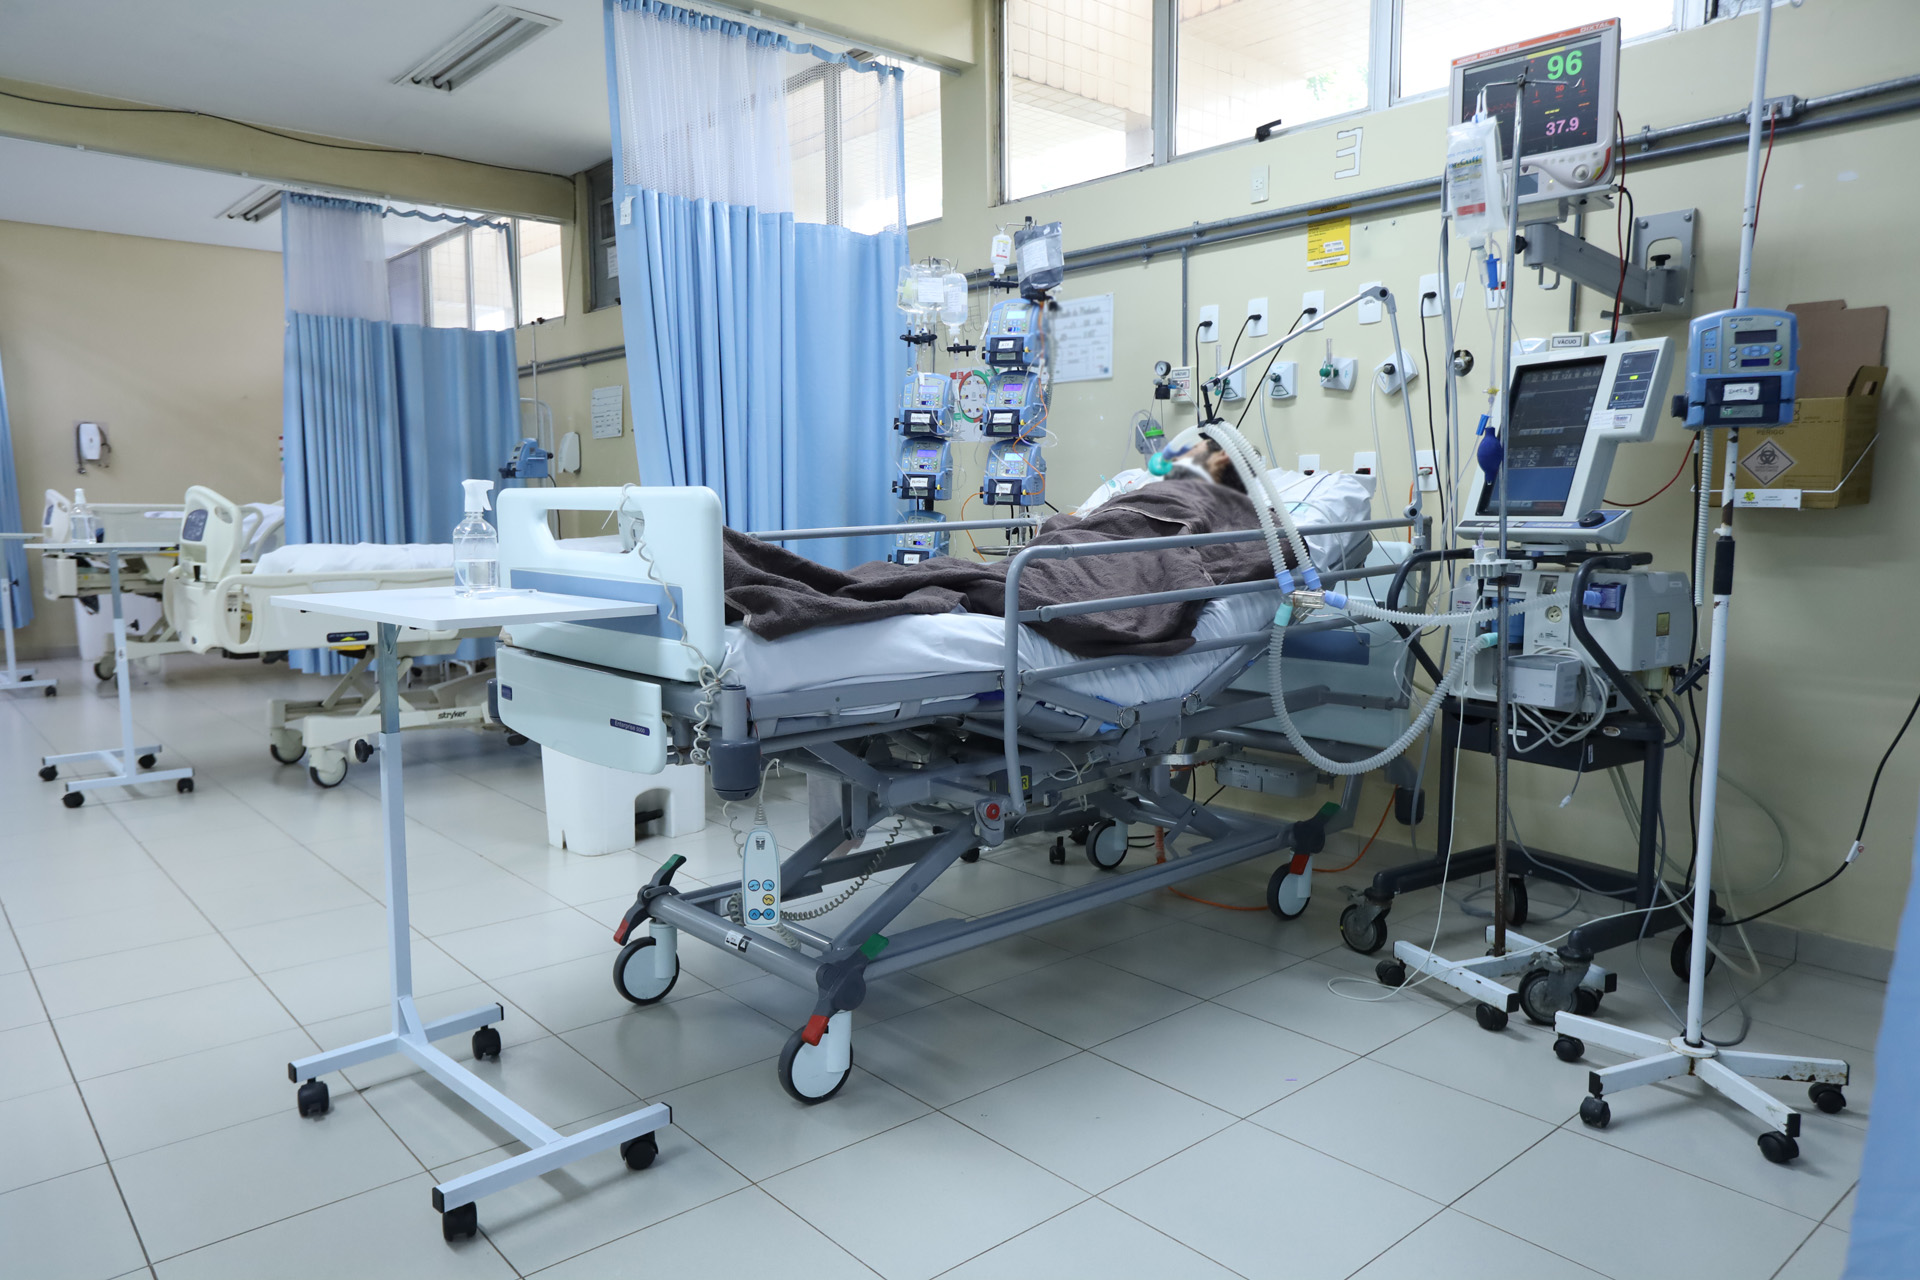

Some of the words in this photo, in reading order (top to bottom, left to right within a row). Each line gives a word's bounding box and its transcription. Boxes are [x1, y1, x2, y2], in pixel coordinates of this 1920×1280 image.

[1547, 50, 1583, 80] 96
[1545, 116, 1580, 136] 37.9
[1334, 126, 1363, 180] 3
[437, 710, 468, 720] stryker
[614, 720, 636, 731] Enterprise
